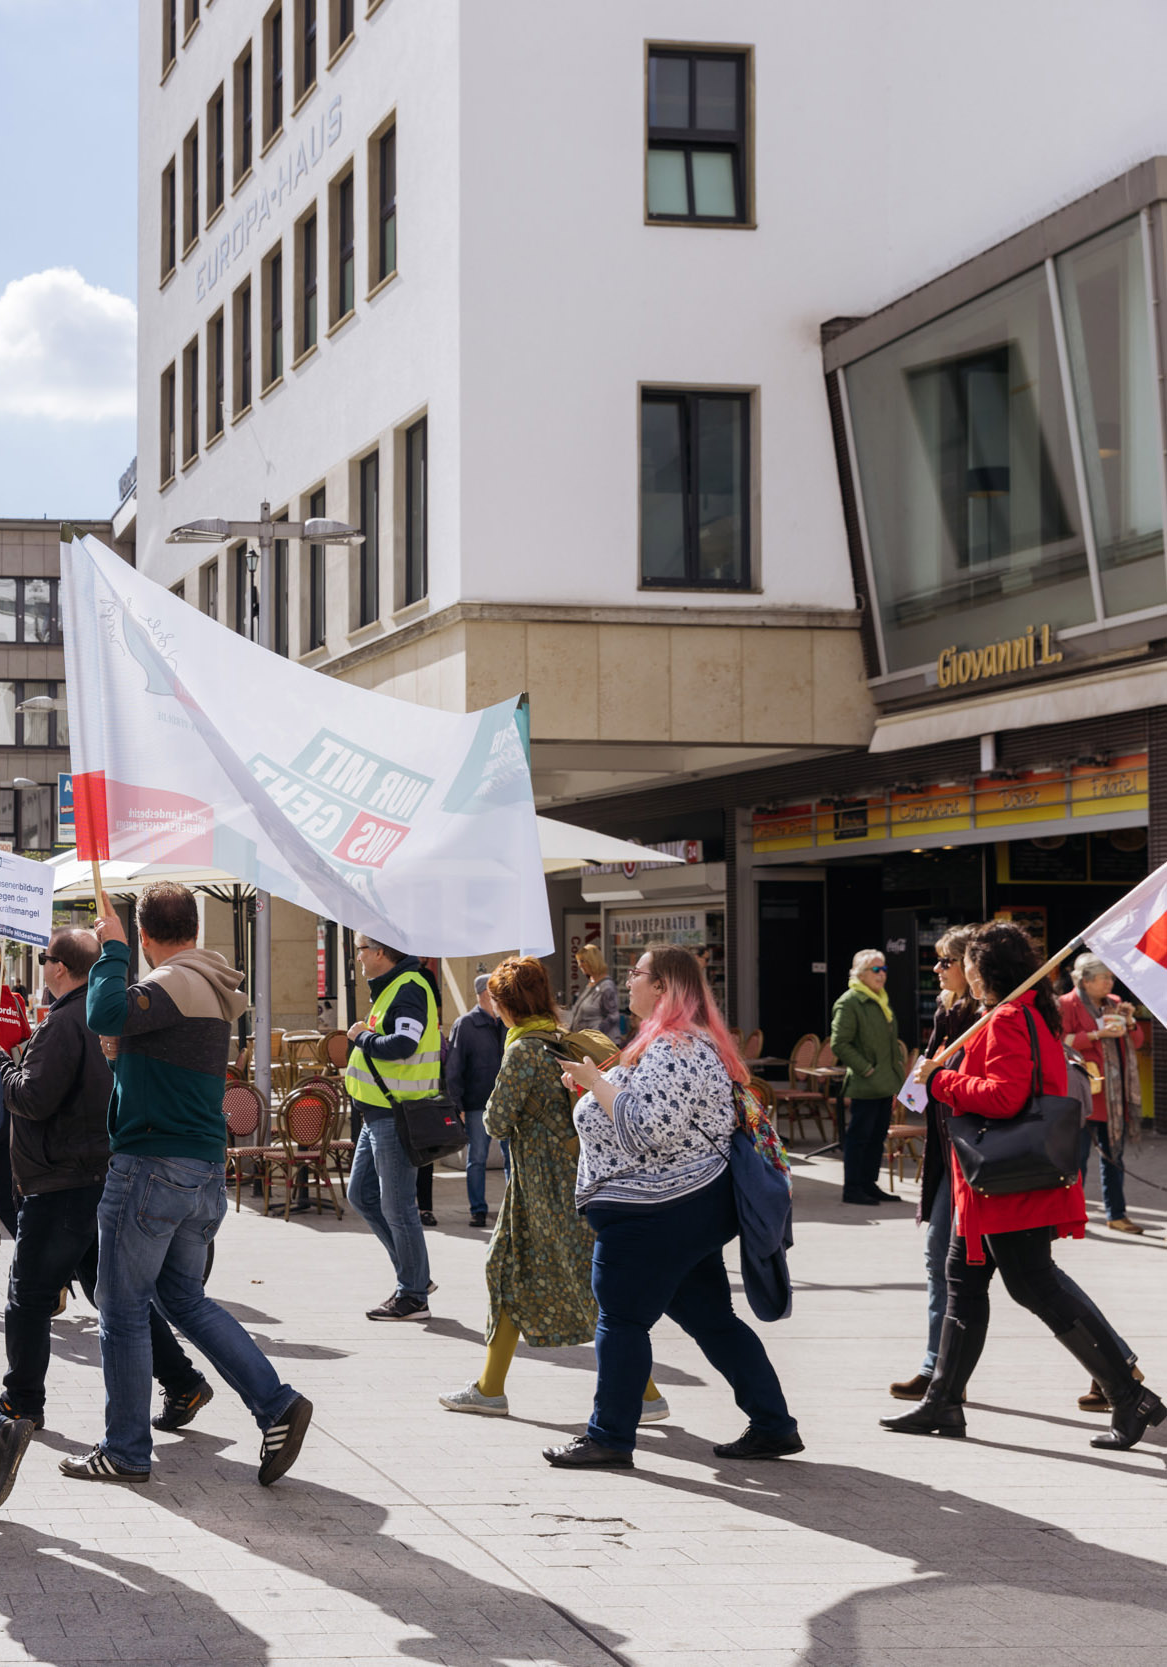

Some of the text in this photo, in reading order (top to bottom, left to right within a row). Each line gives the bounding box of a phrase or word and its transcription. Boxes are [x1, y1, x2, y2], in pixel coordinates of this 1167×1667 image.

[937, 623, 1063, 688] Giovanni L.
[16, 894, 28, 904] den
[614, 915, 697, 933] HANDYREPARATUR
